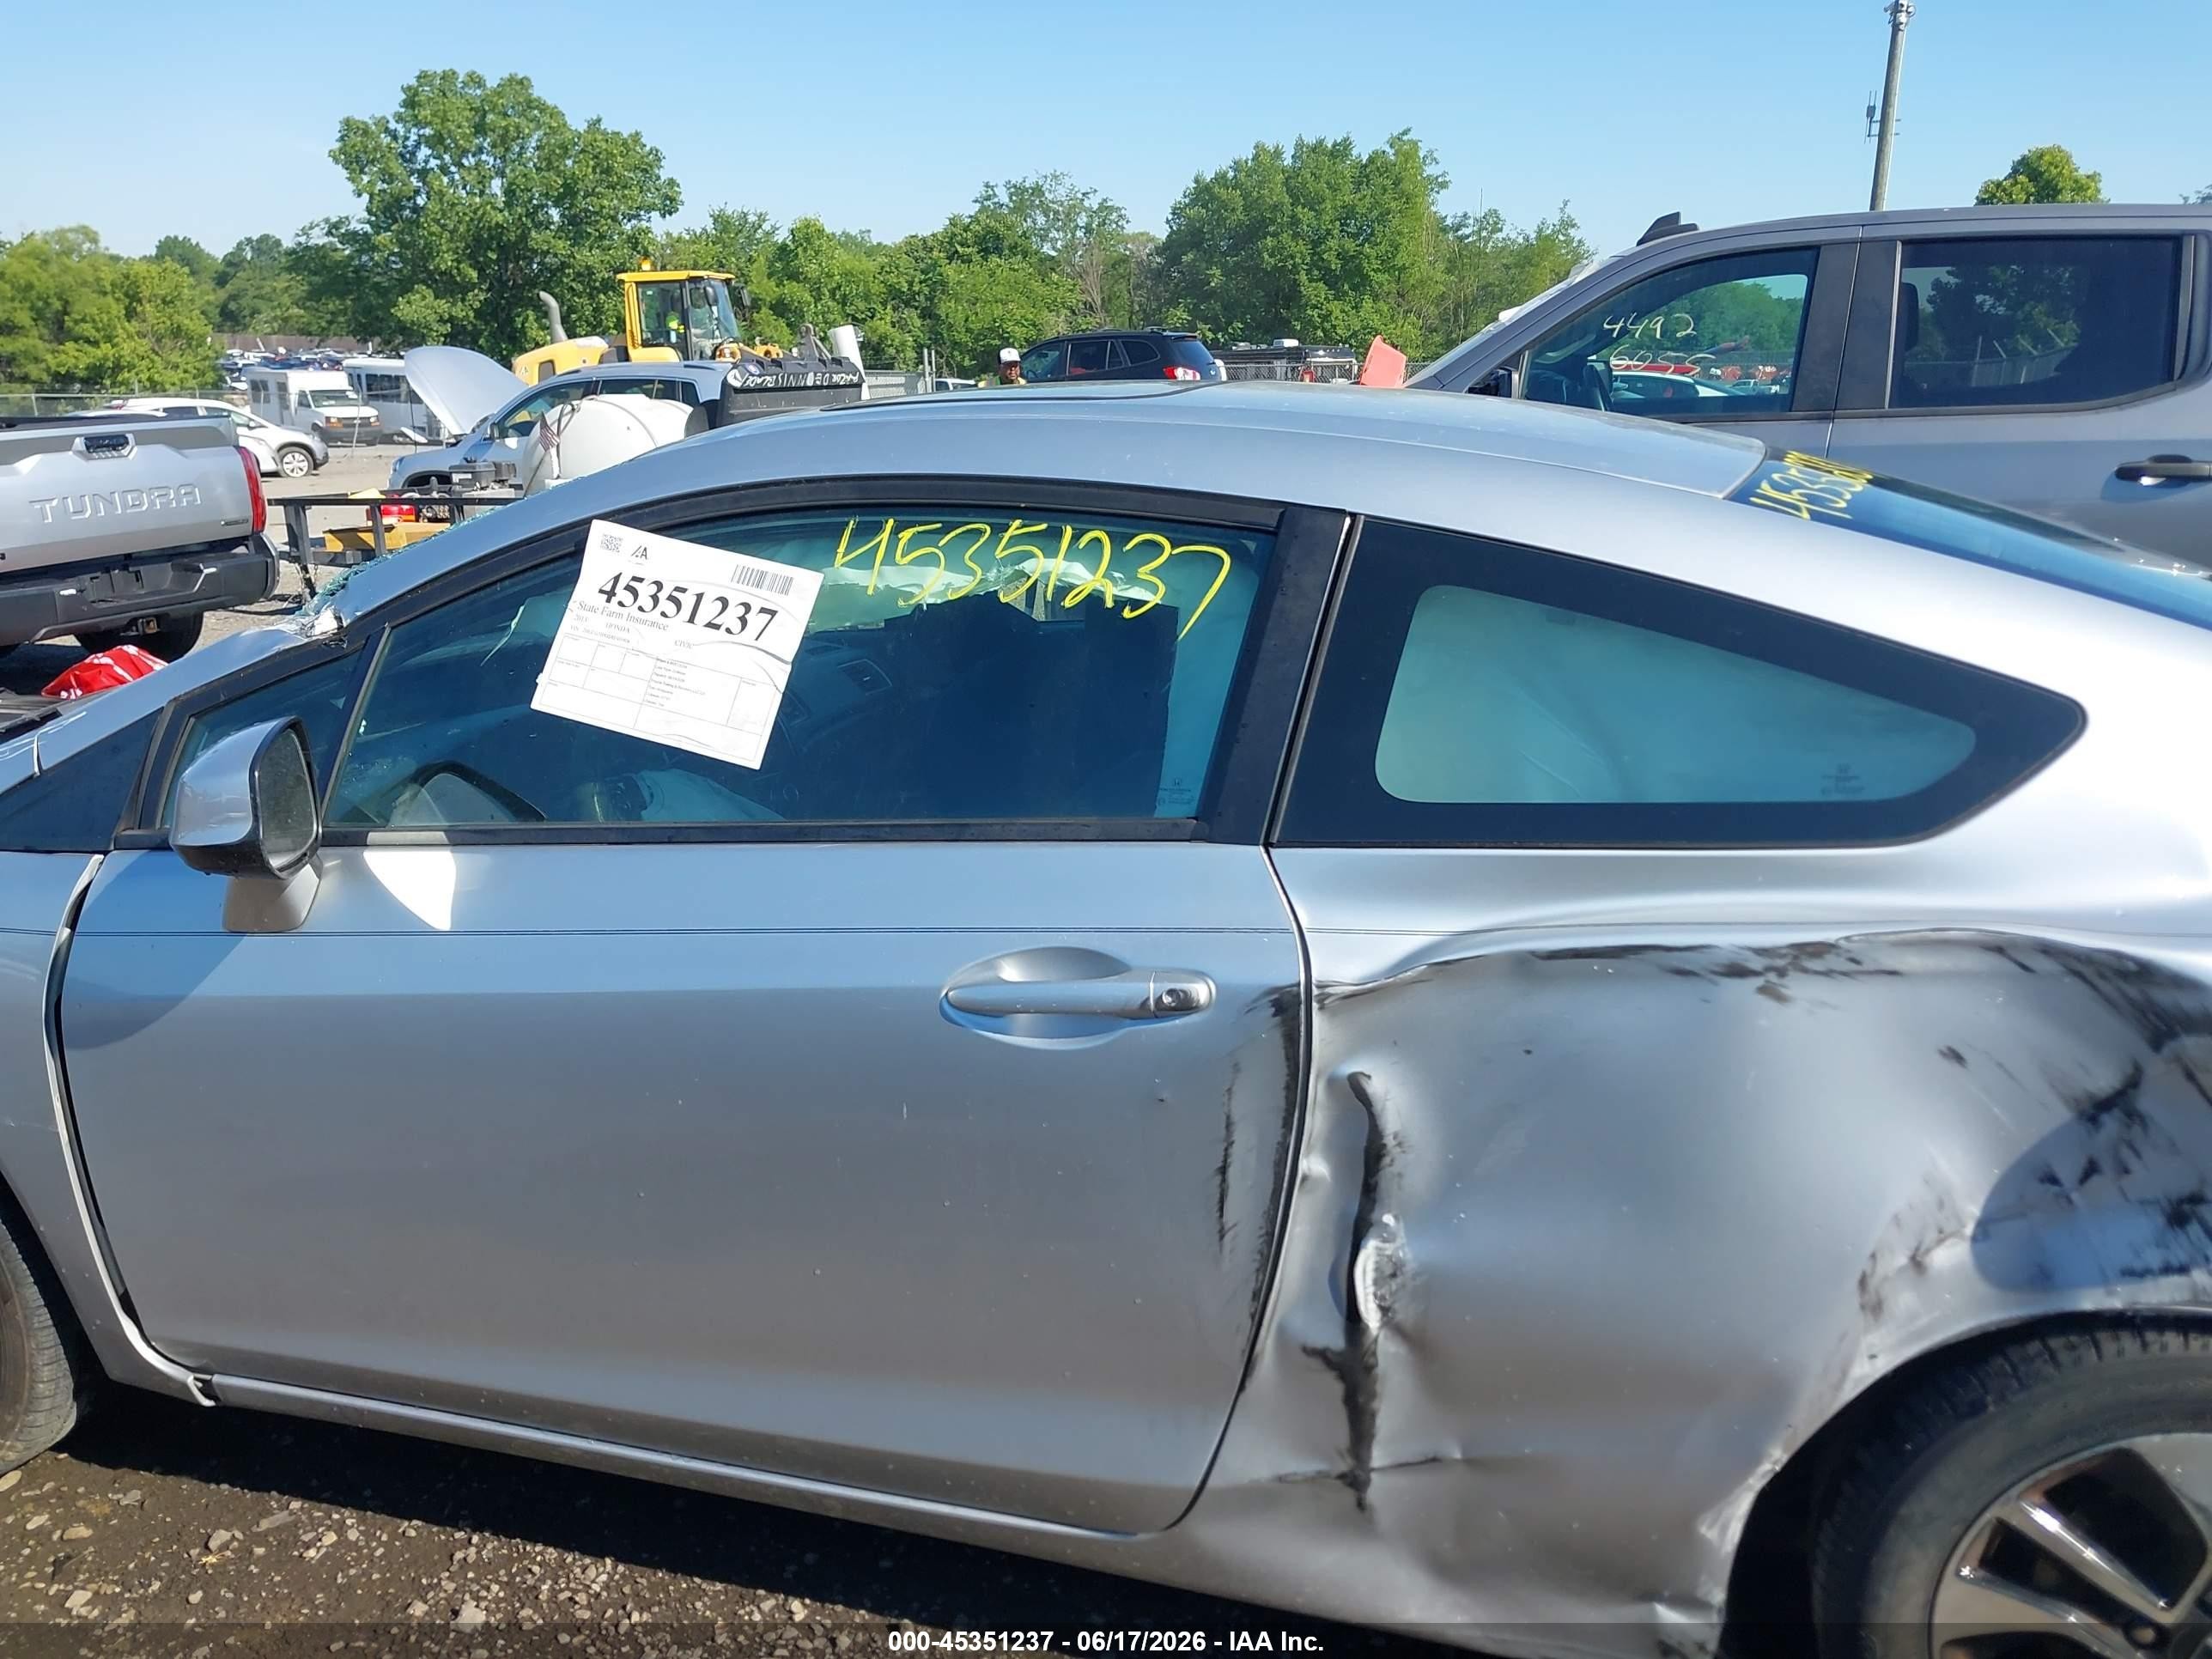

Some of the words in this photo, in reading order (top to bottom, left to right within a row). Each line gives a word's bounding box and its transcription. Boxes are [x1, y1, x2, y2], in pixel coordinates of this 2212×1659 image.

[1603, 312, 1697, 339] 4492
[29, 483, 202, 524] TUNDRA
[834, 515, 1231, 643] 45351237
[577, 600, 599, 614] State
[600, 606, 623, 619] Farm
[626, 612, 669, 631] Insurance
[598, 571, 778, 641] 45351237
